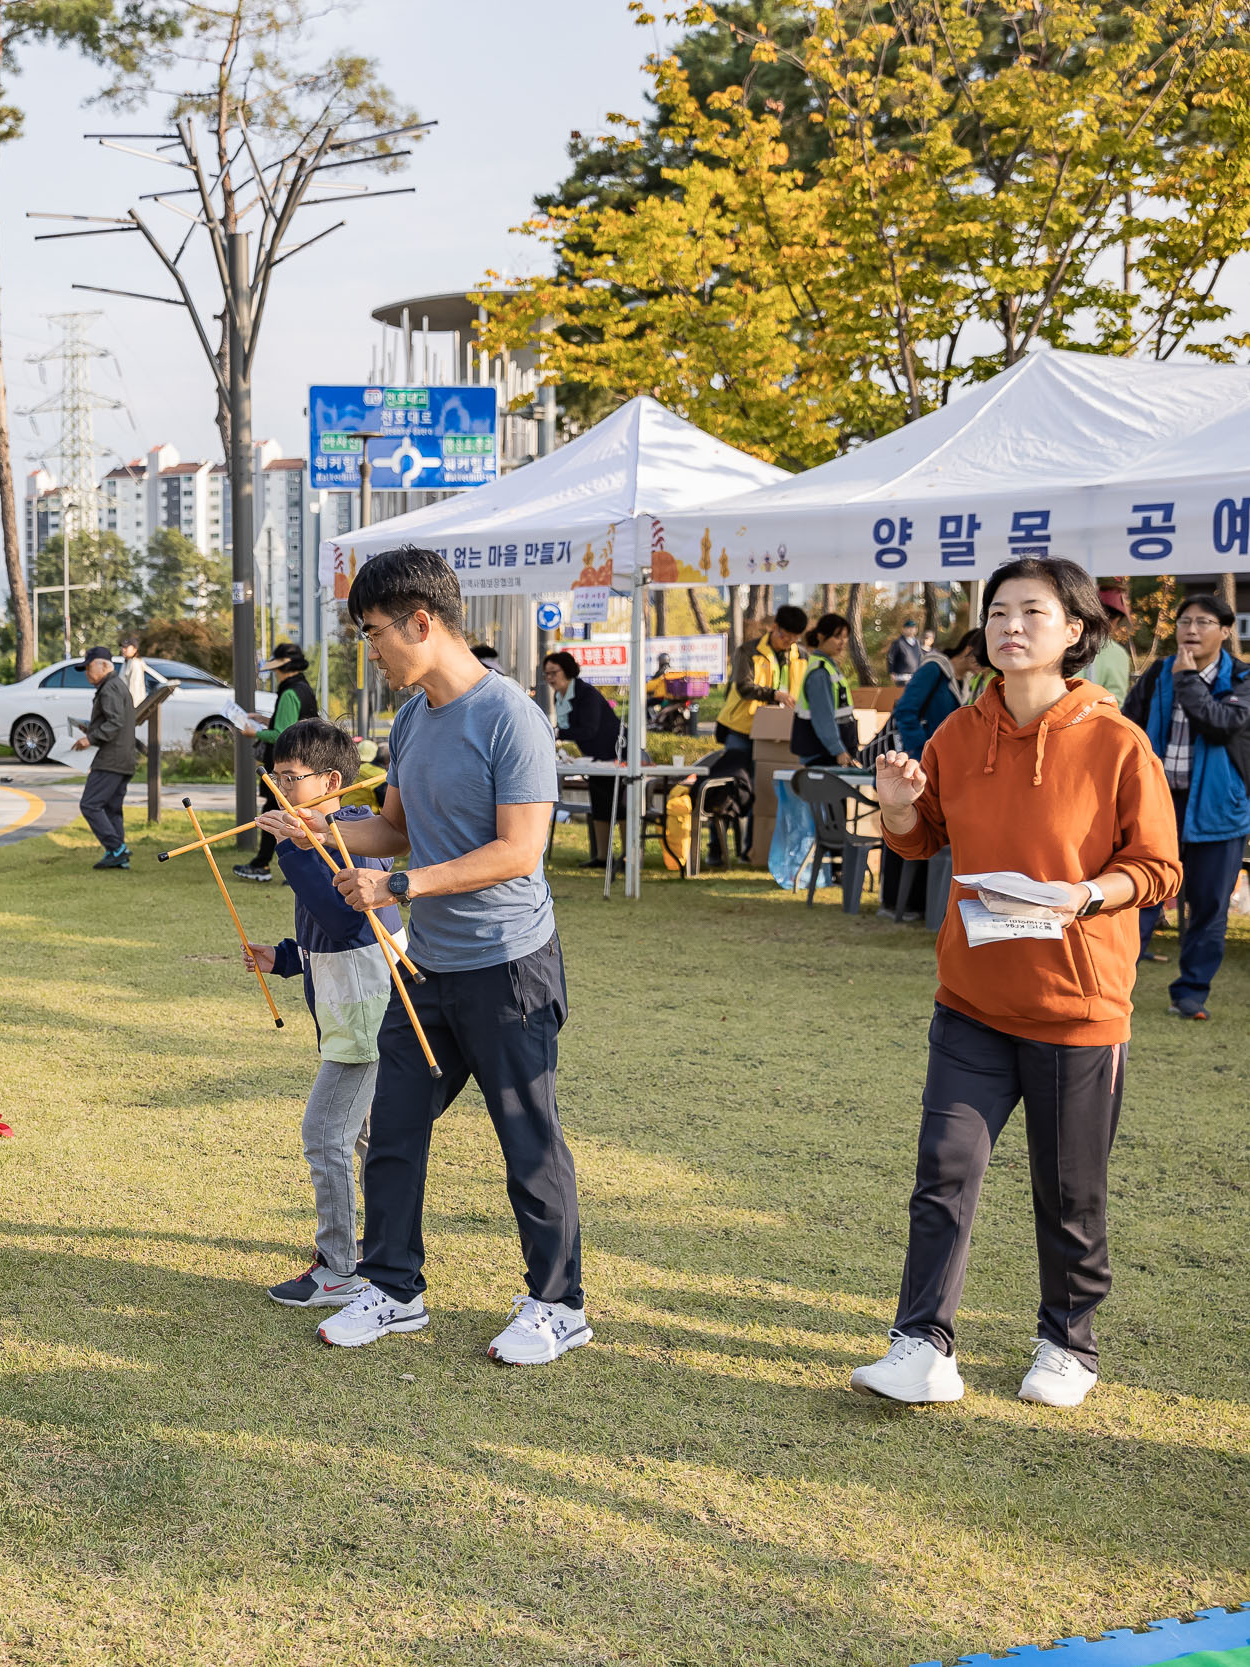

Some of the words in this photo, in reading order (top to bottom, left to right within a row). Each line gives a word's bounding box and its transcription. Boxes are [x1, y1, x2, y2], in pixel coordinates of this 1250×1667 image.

[381, 410, 432, 426] 천호대로
[454, 547, 482, 569] 없는
[488, 544, 518, 567] 마을
[524, 541, 572, 566] 만들기
